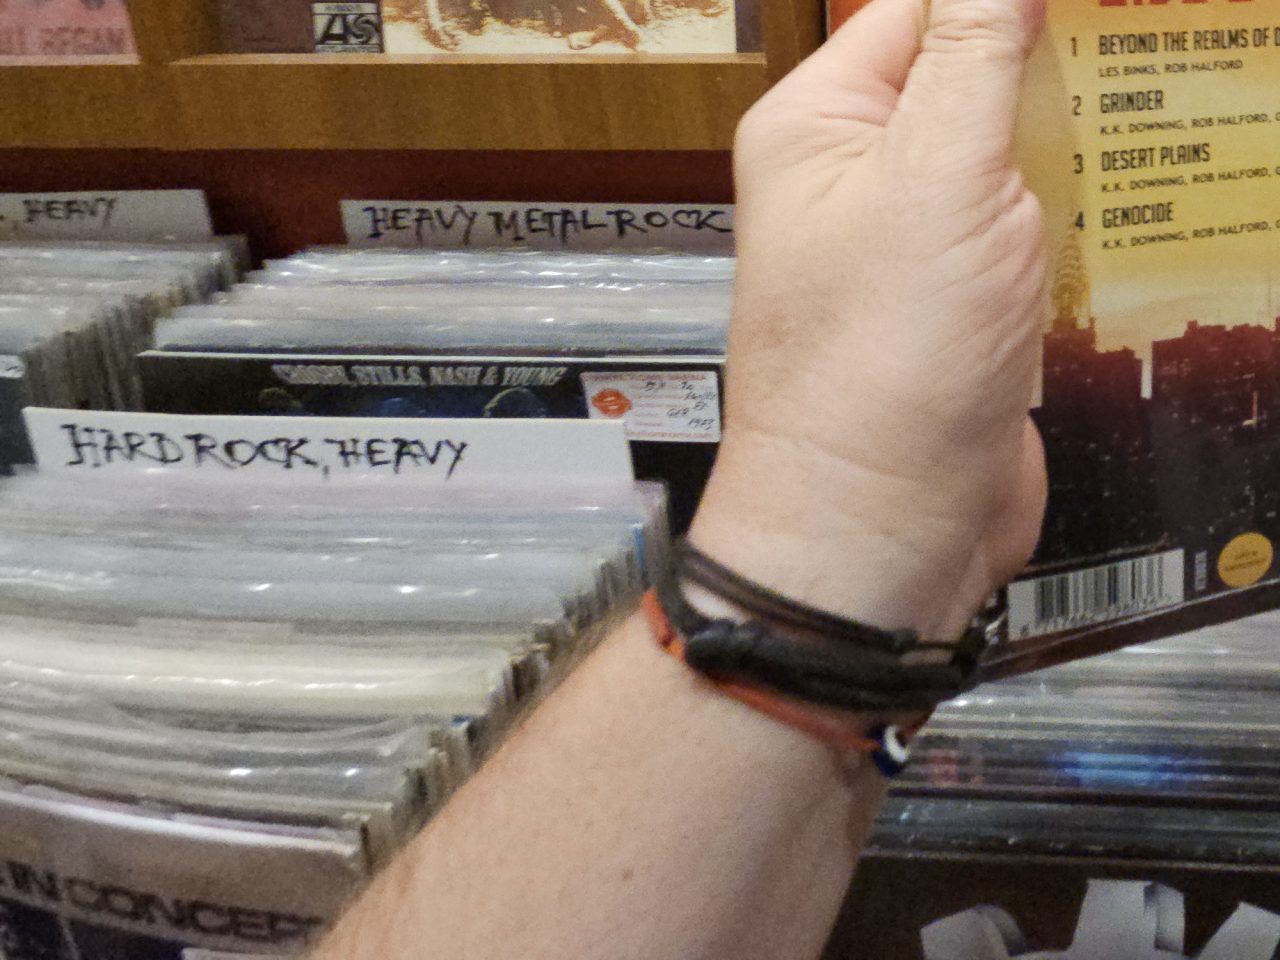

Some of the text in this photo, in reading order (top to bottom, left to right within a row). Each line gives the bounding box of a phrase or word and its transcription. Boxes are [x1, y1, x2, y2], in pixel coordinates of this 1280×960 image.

[1071, 36, 1078, 58] 1
[1098, 31, 1158, 56] BEYOND
[1162, 31, 1188, 53] THE
[1192, 28, 1249, 51] REALMS
[1252, 27, 1272, 49] OF
[1098, 66, 1120, 78] LES
[1164, 61, 1188, 73] ROB
[1191, 59, 1243, 72] HALFORD
[1072, 94, 1082, 117] 2
[1100, 90, 1165, 114] GRINDER
[1073, 153, 1084, 175] 3
[1101, 147, 1155, 172] DESERT
[1160, 143, 1212, 166] PLAINS
[22, 196, 118, 229] HEAVY
[363, 204, 733, 244] HEAVY METAL ROCK
[1074, 211, 1085, 232] 4
[1102, 201, 1175, 229] GENOCIDE
[429, 366, 483, 386] NASH
[481, 366, 498, 386] &
[500, 366, 569, 386] YOUNG
[61, 423, 185, 468] HARD
[325, 437, 469, 481] HEAVY
